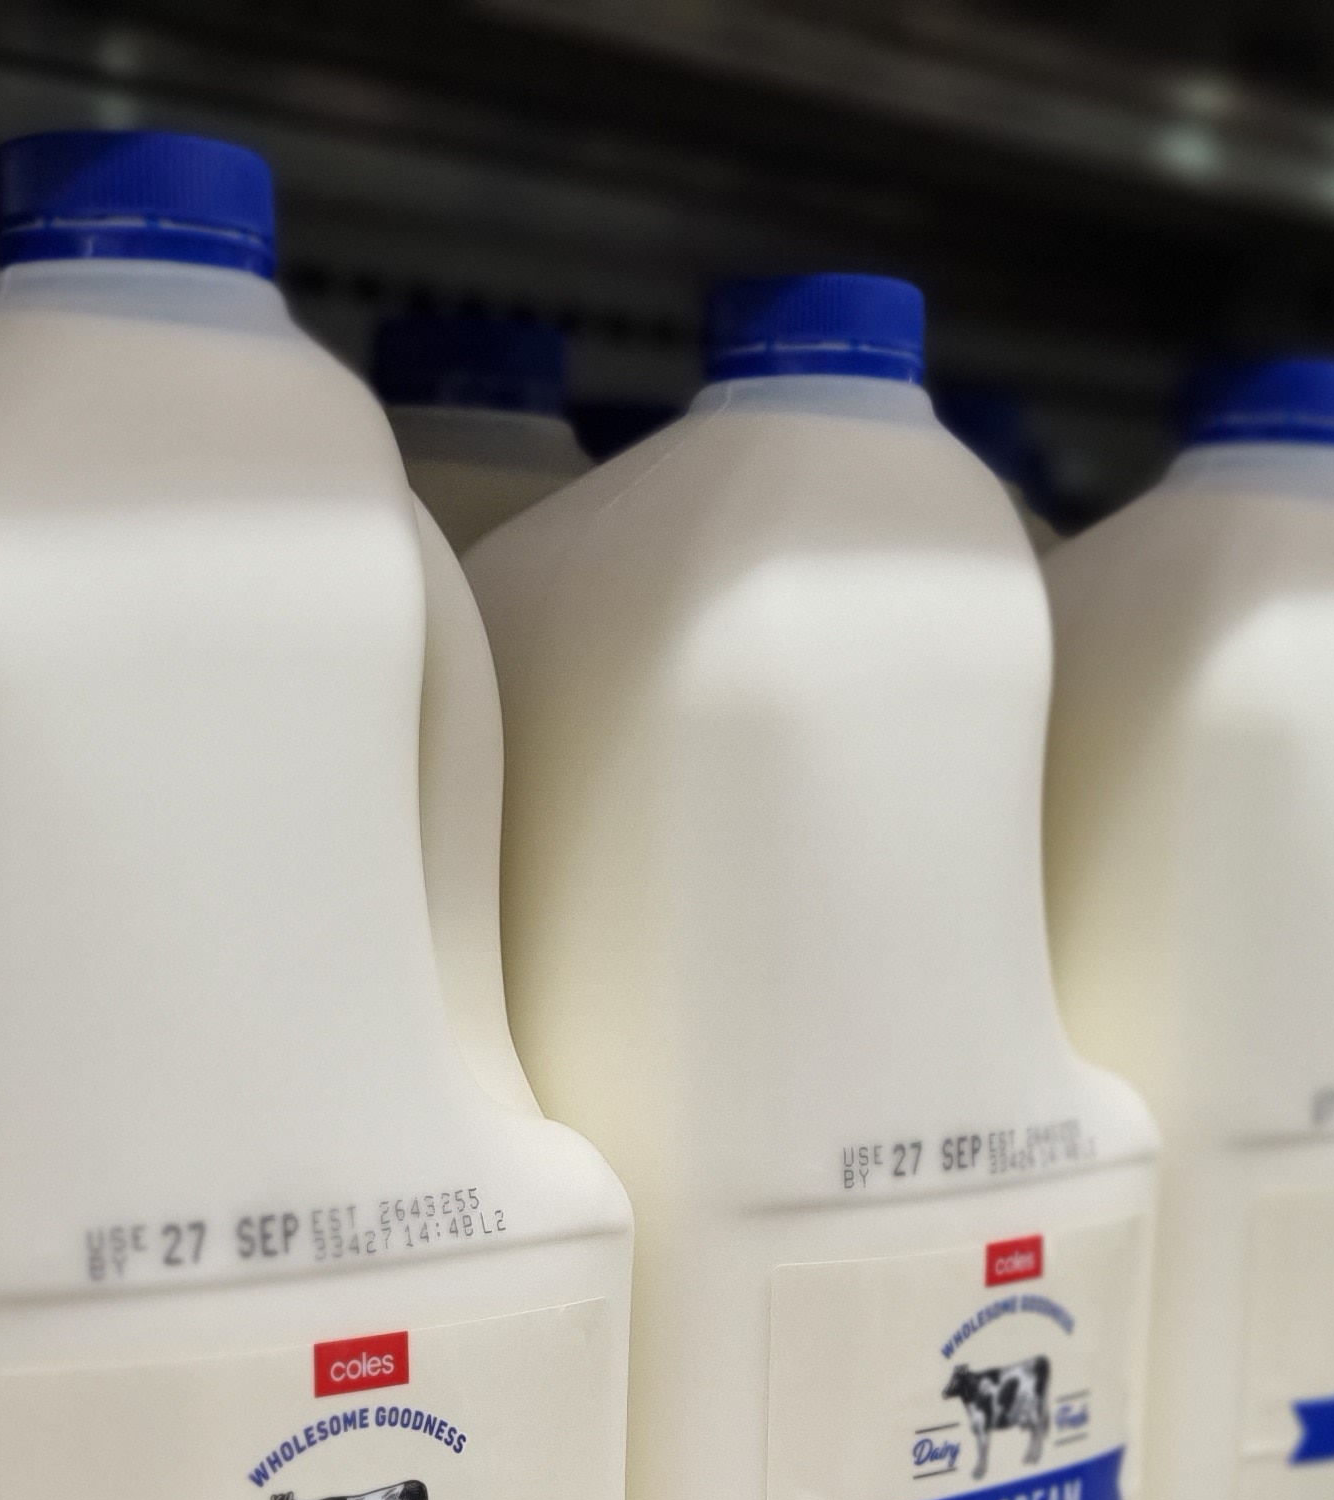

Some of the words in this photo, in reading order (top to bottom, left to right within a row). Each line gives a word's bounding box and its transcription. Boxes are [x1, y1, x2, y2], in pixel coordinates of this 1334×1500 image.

[843, 1145, 883, 1167] USE
[893, 1140, 923, 1177] 27
[942, 1134, 982, 1171] SEP
[844, 1169, 869, 1189] BY
[87, 1223, 147, 1255] USE
[162, 1221, 207, 1267] 27
[236, 1212, 299, 1260] SEP
[311, 1205, 357, 1236] EST
[379, 1187, 480, 1227] 2643255
[88, 1252, 127, 1282] BY
[330, 1352, 394, 1382] coles
[248, 1407, 370, 1488] WHOLESOME
[374, 1406, 467, 1454] GOODNESS
[913, 1438, 960, 1468] Dairy
